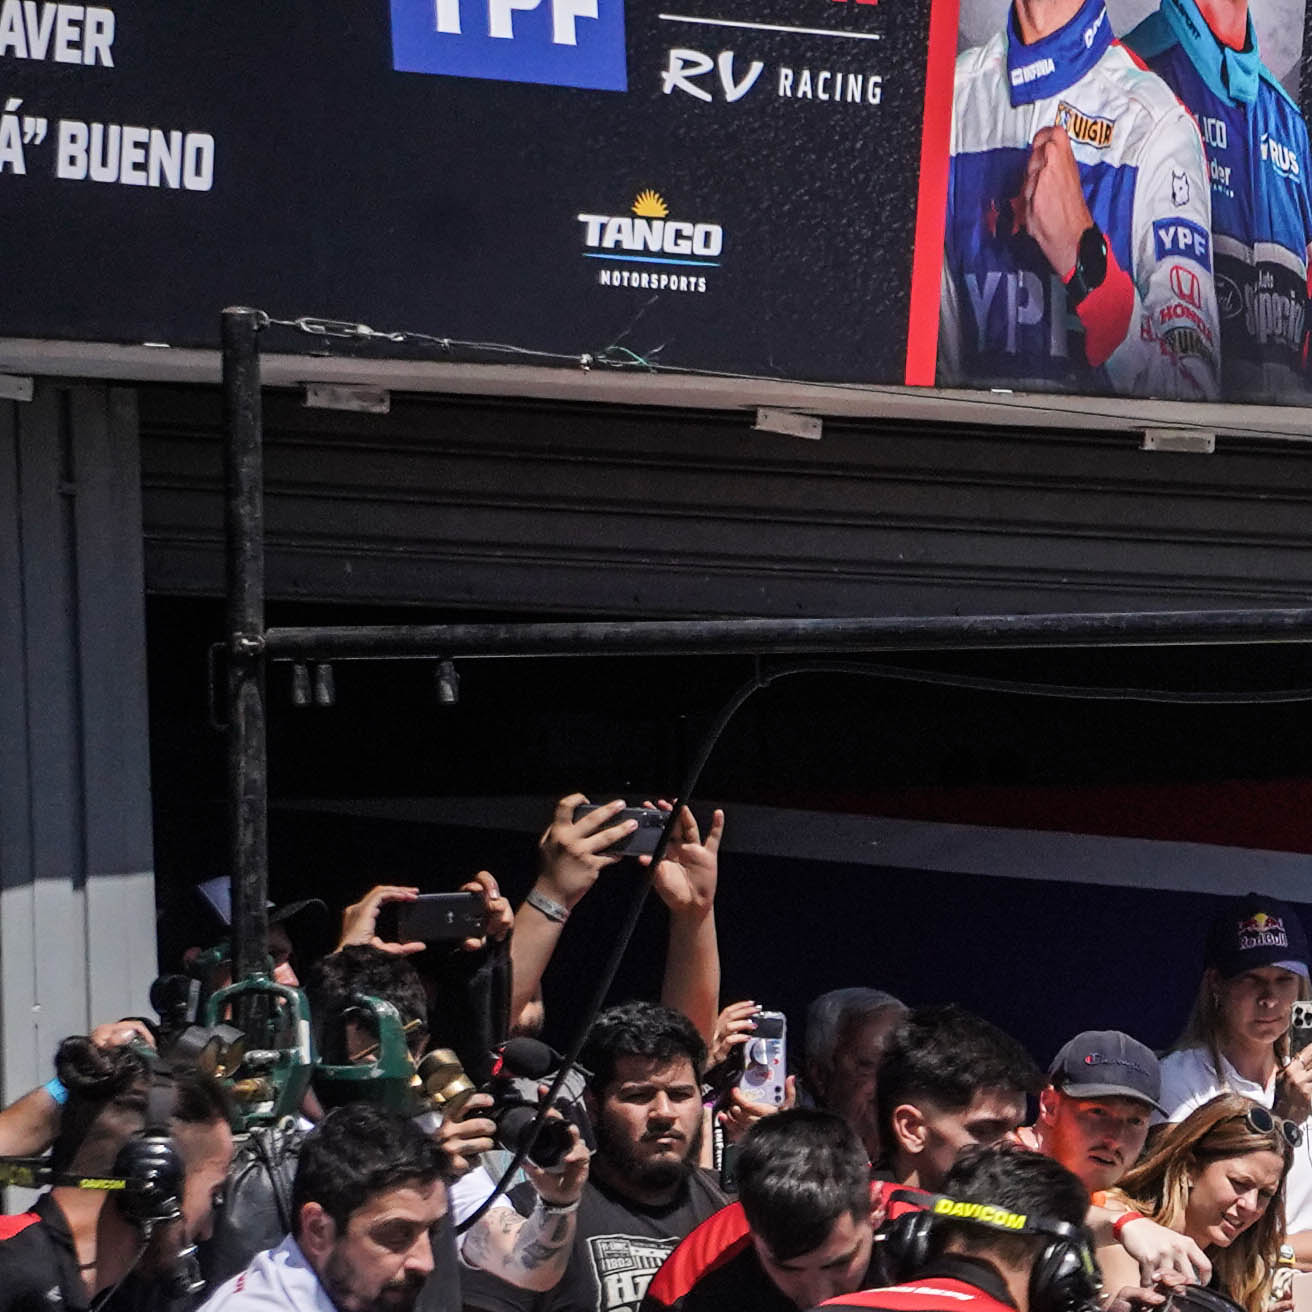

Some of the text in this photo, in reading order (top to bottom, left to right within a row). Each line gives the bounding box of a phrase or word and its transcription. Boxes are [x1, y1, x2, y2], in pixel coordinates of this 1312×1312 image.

[661, 47, 883, 106] RV RACING
[55, 118, 214, 192] BUENO
[578, 213, 724, 258] TANGO
[1158, 226, 1207, 256] YPF
[599, 269, 708, 294] MOTORSPORTS
[934, 1198, 1028, 1231] DAVICOM
